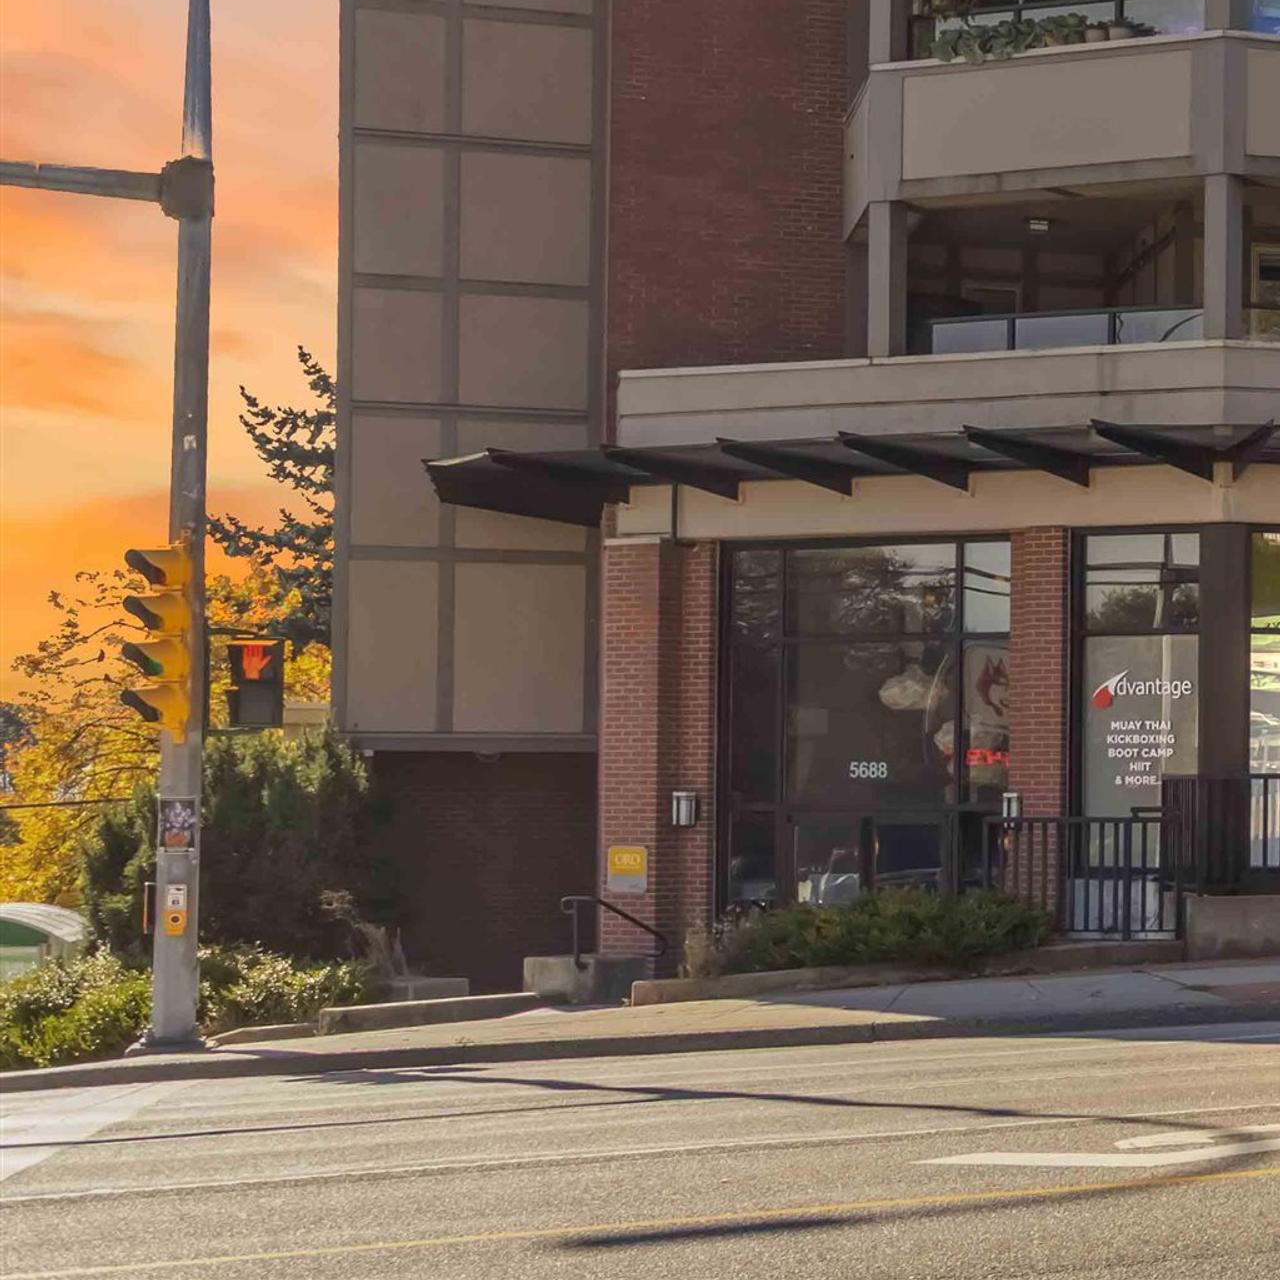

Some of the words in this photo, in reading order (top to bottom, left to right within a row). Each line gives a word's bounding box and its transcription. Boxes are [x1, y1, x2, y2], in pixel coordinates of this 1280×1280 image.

[1111, 721, 1141, 730] MUAY
[1145, 721, 1171, 730] THAI
[1107, 735, 1175, 744] KICKBOXING
[1108, 748, 1138, 757] BOOT
[1142, 748, 1174, 757] CAMP
[850, 762, 887, 778] 5688
[1130, 762, 1152, 771] HIIT
